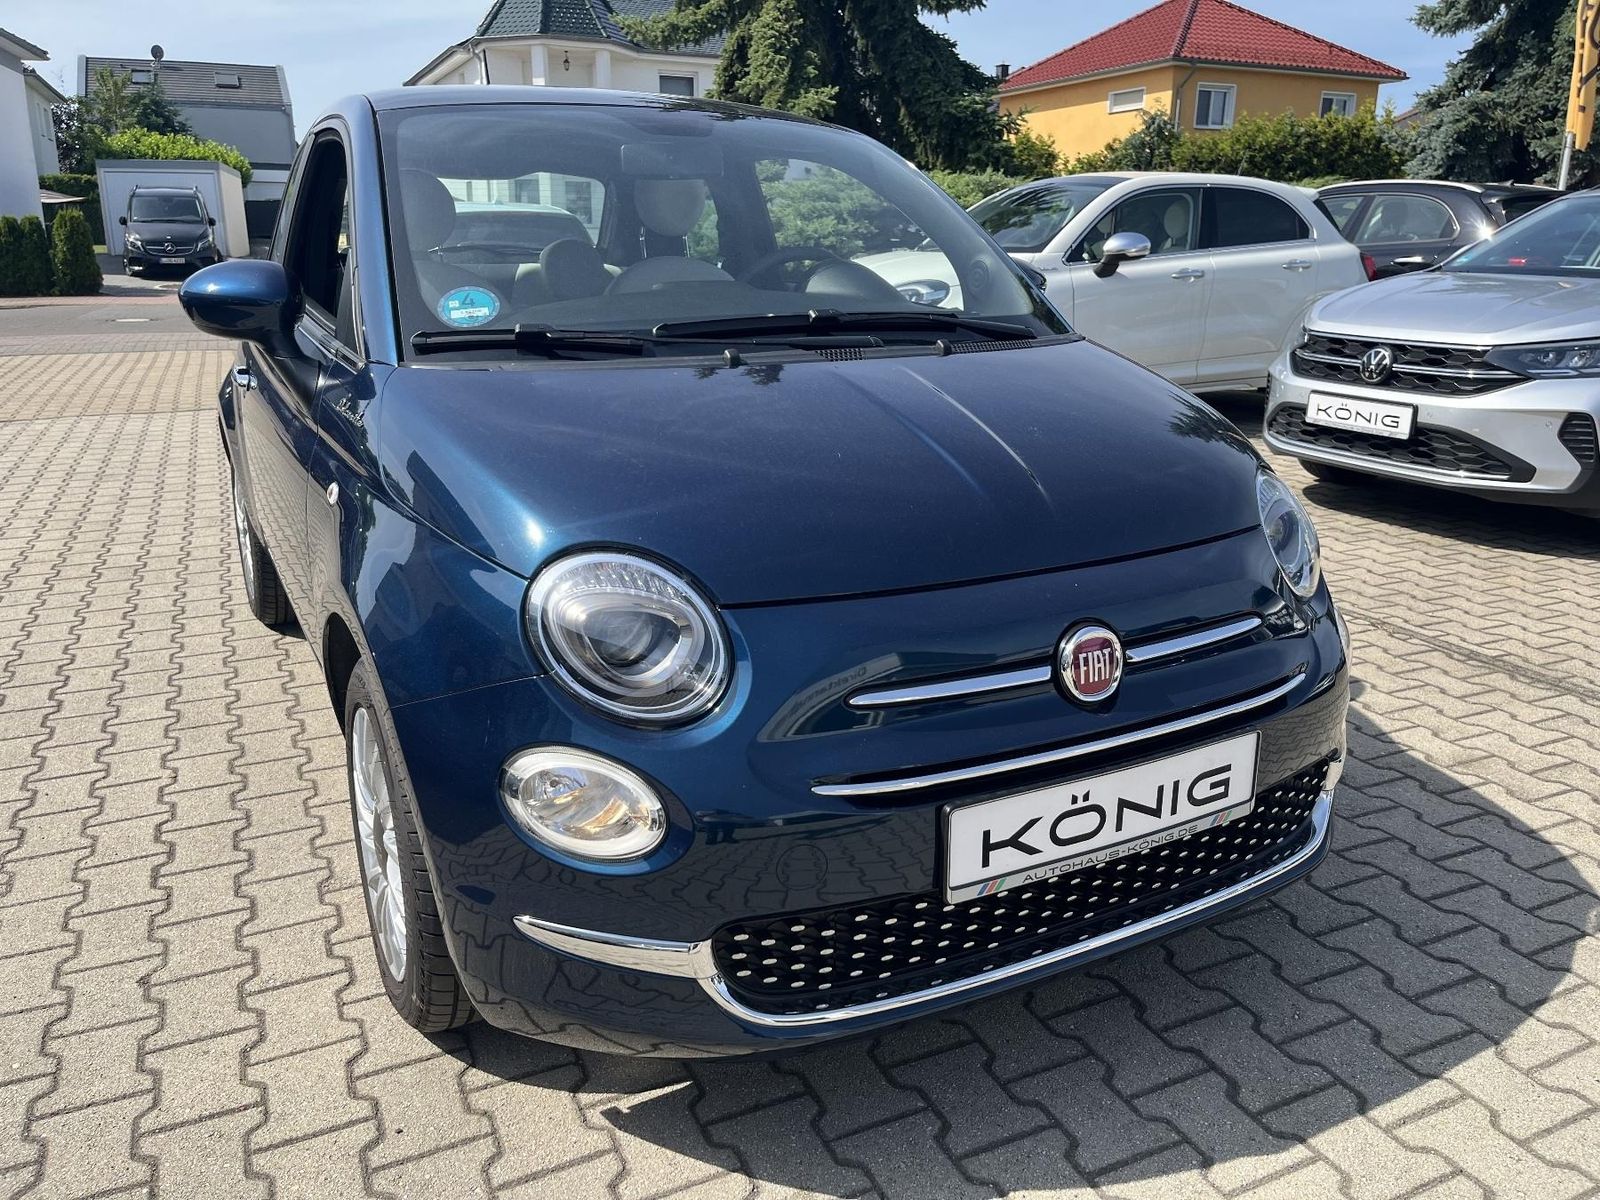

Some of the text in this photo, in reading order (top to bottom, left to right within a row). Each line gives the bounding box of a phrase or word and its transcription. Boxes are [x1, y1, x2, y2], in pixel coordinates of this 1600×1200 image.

[461, 291, 476, 307] 4
[1316, 402, 1401, 429] KÖNIG
[1078, 647, 1111, 685] FIAT
[981, 763, 1232, 868] KÖNIG
[1022, 825, 1198, 884] AUTOHAUS-KÖNIG.DE
